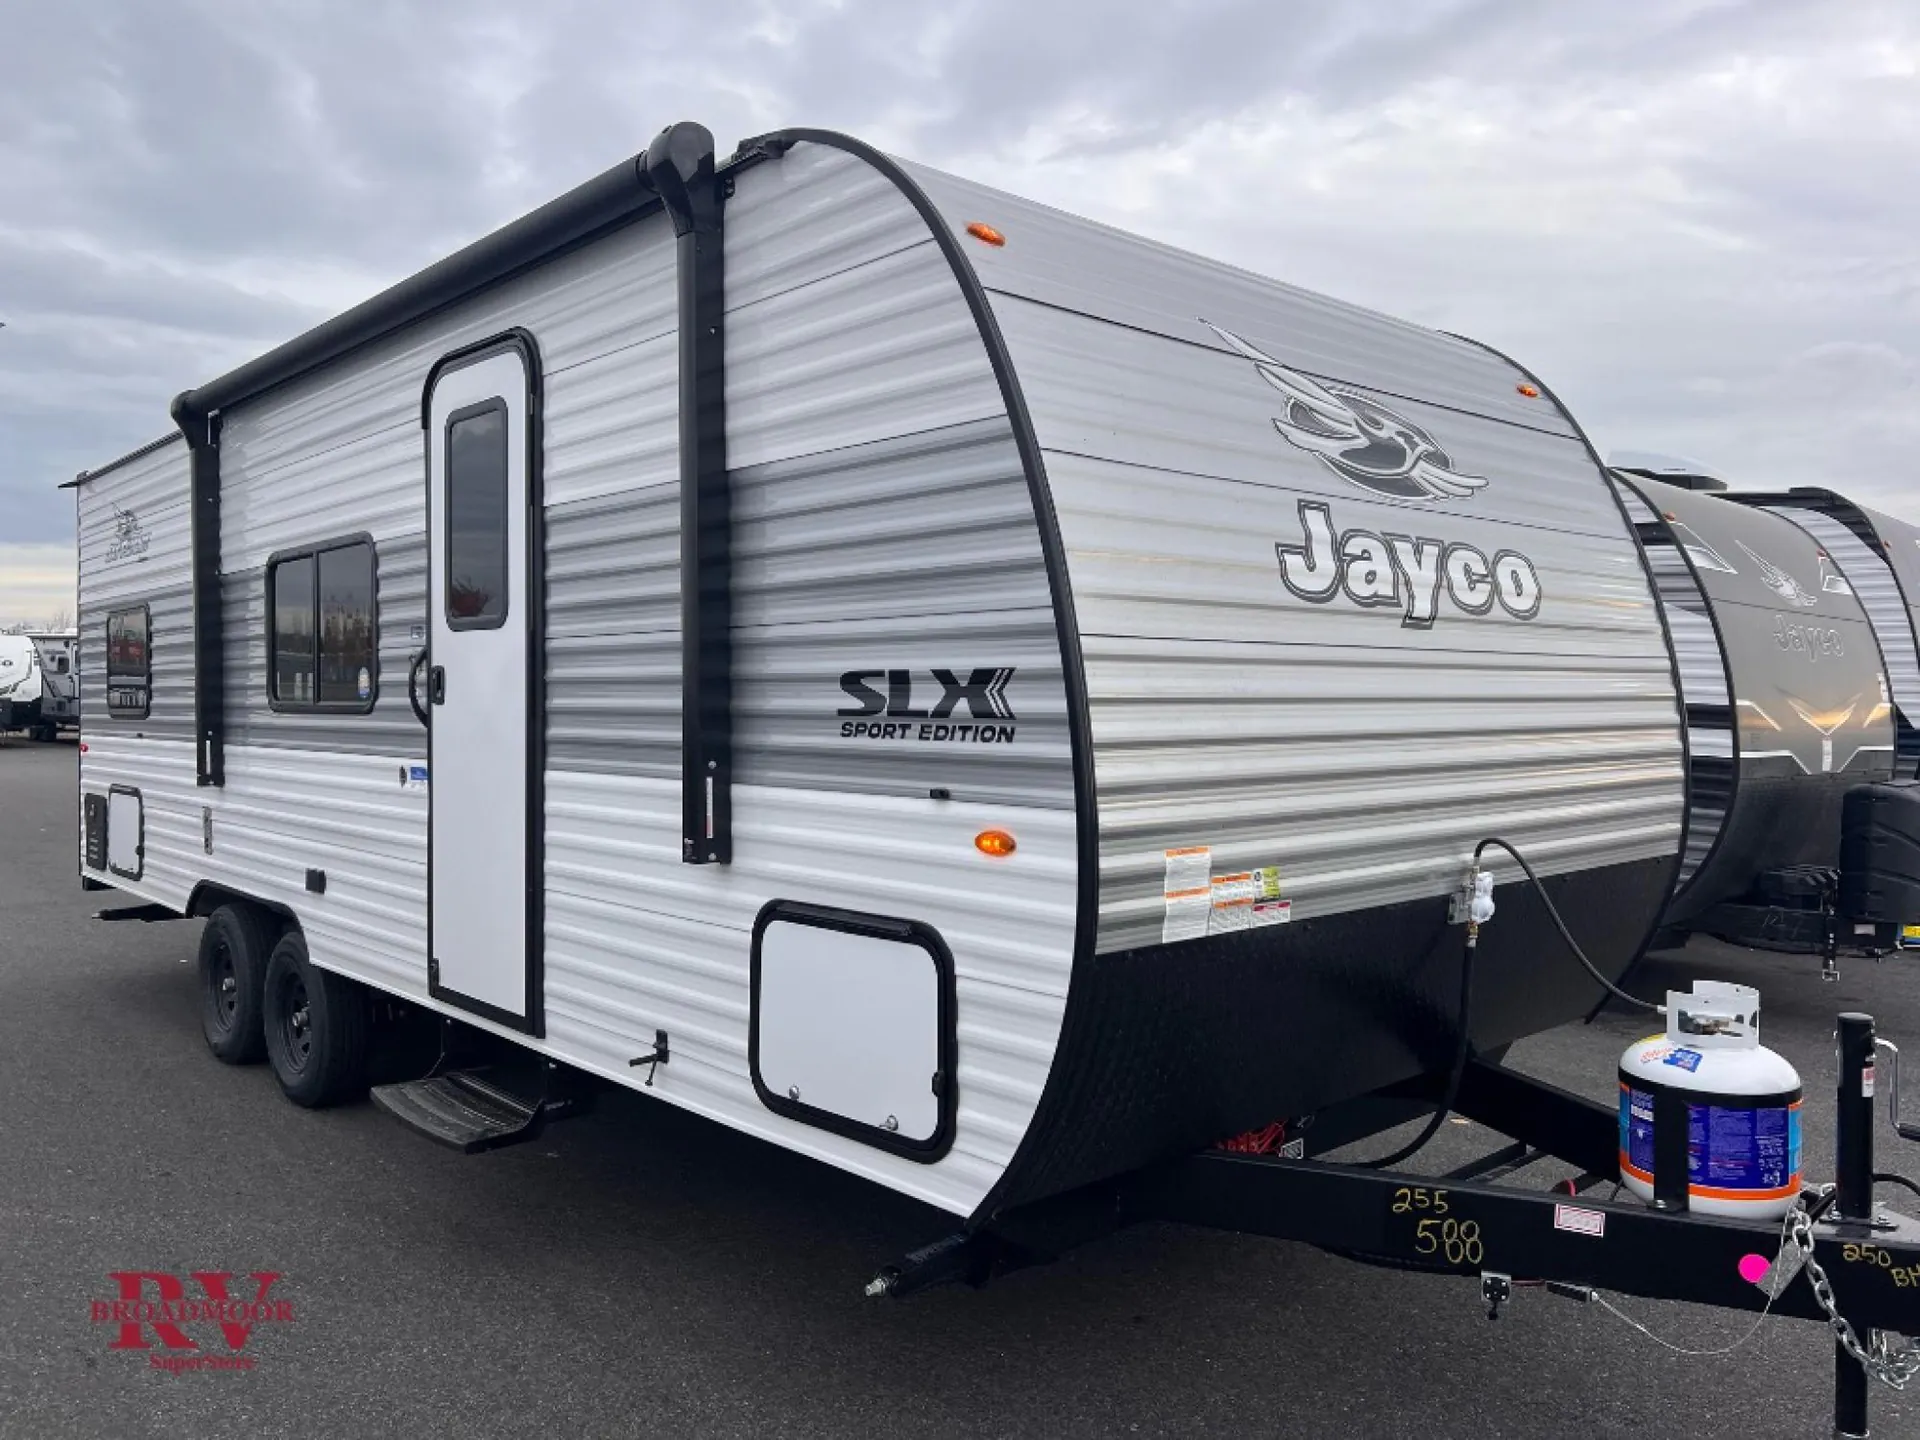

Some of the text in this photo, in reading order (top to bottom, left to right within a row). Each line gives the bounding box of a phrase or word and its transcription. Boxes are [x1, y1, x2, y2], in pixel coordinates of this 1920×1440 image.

[1275, 498, 1542, 630] Jayco
[1773, 613, 1844, 662] Jayco
[837, 667, 1017, 720] SLX
[840, 721, 1016, 744] SPORT EDITION
[1392, 1188, 1449, 1214] 255
[1415, 1218, 1484, 1265] 588
[1842, 1242, 1892, 1267] 250
